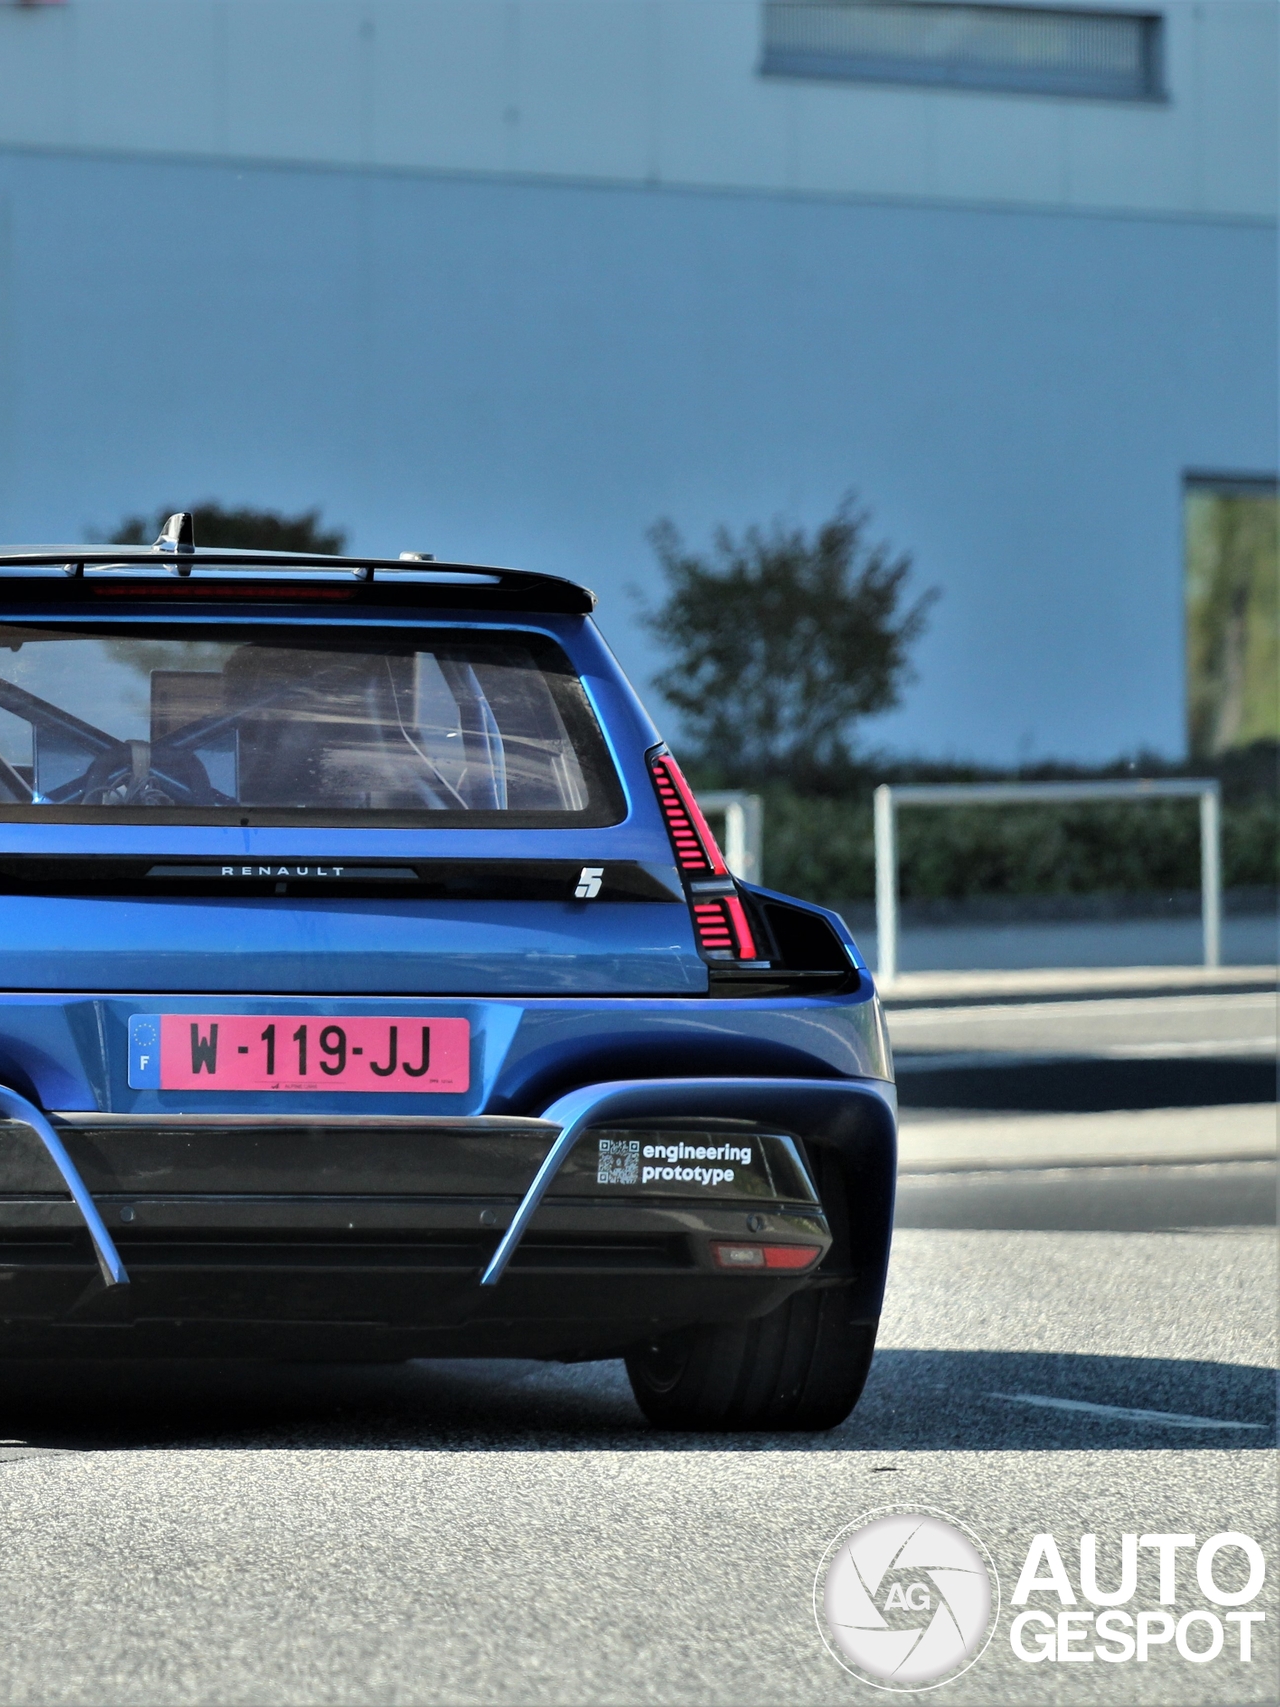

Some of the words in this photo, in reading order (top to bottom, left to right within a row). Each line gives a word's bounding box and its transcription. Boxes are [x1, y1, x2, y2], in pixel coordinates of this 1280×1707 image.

[221, 866, 344, 876] RENAULT
[574, 867, 604, 898] 5
[190, 1023, 430, 1077] W-119-JJ
[140, 1055, 150, 1071] F
[643, 1142, 751, 1164] engineering
[642, 1165, 734, 1185] prototype
